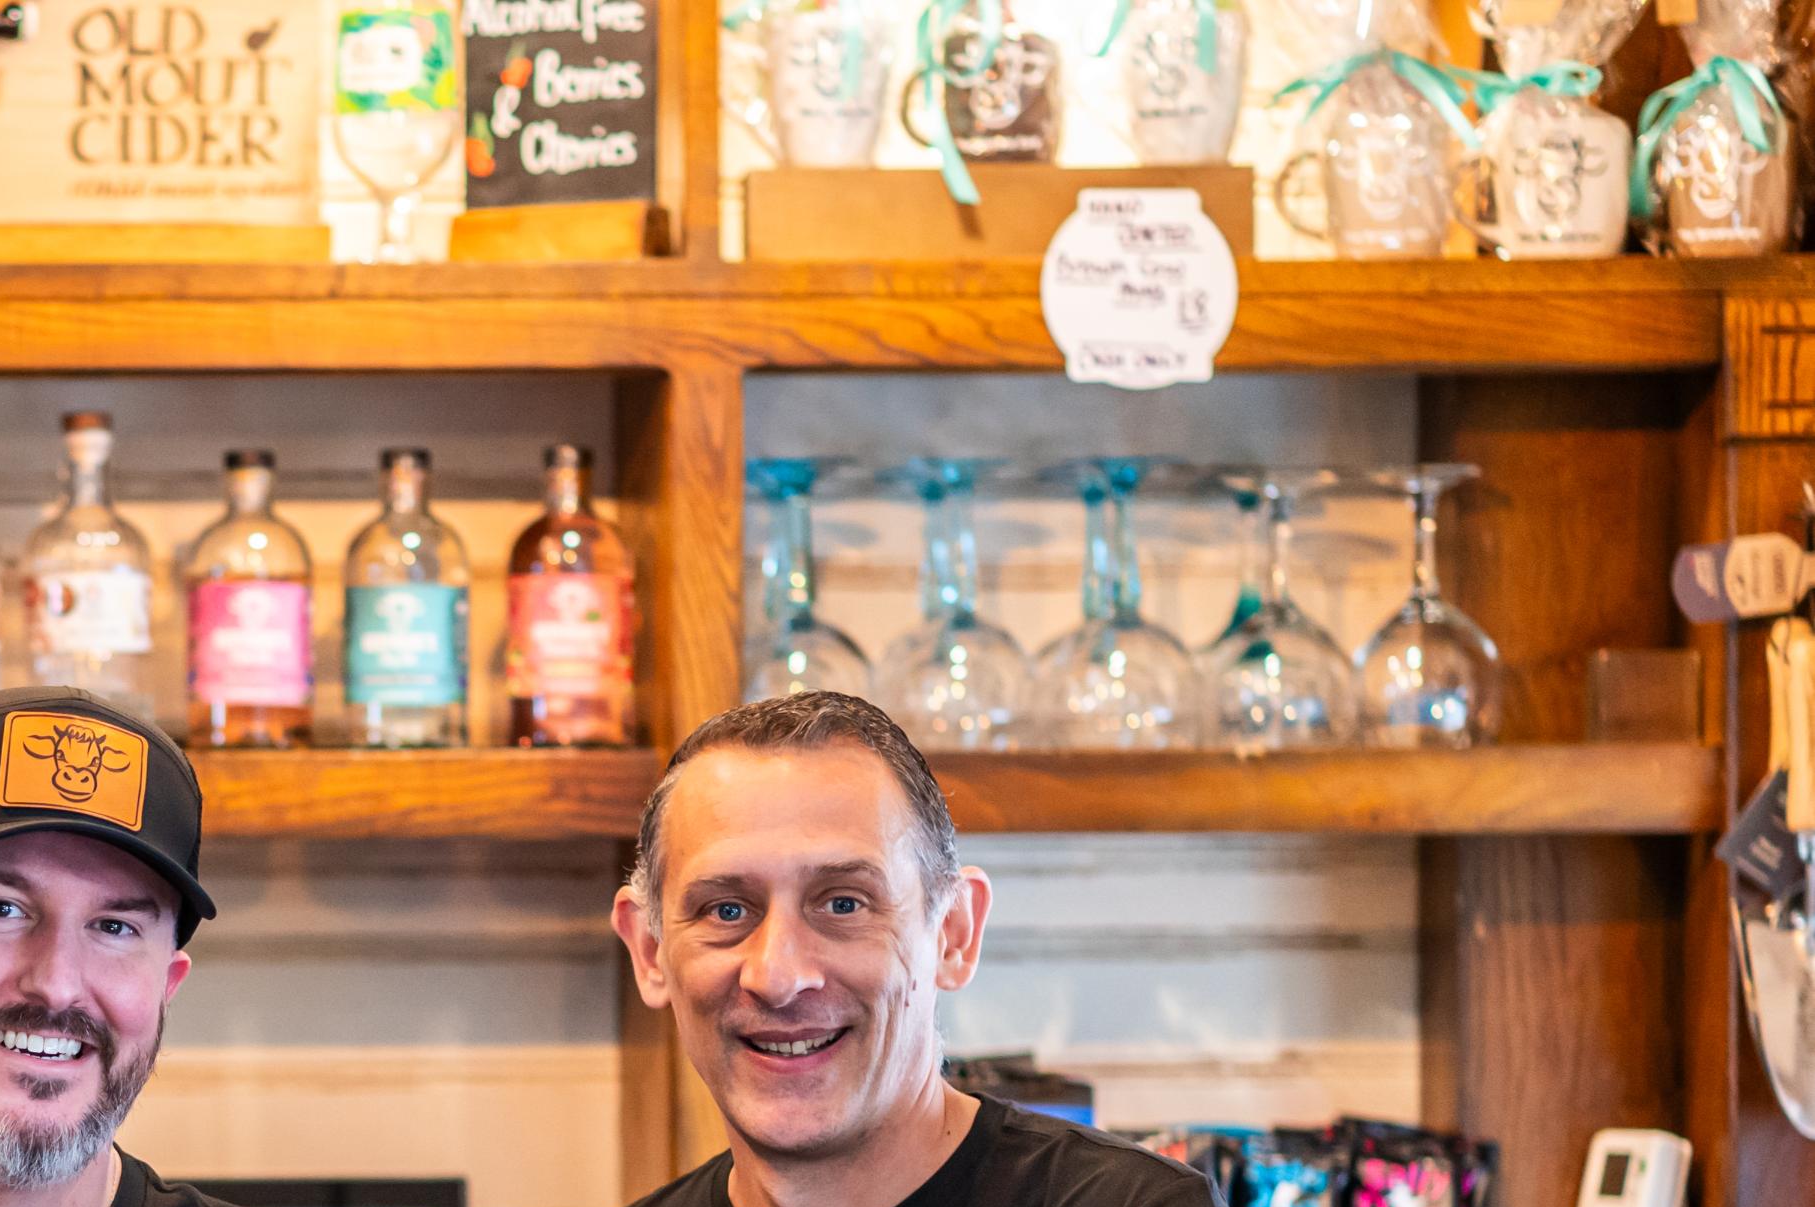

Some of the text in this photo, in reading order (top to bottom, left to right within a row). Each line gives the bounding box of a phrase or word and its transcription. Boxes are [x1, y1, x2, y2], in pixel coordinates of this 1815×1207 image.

[72, 7, 205, 55] OLD
[78, 56, 292, 107] MOUT
[533, 48, 646, 108] Berries
[71, 114, 280, 166] CIDER
